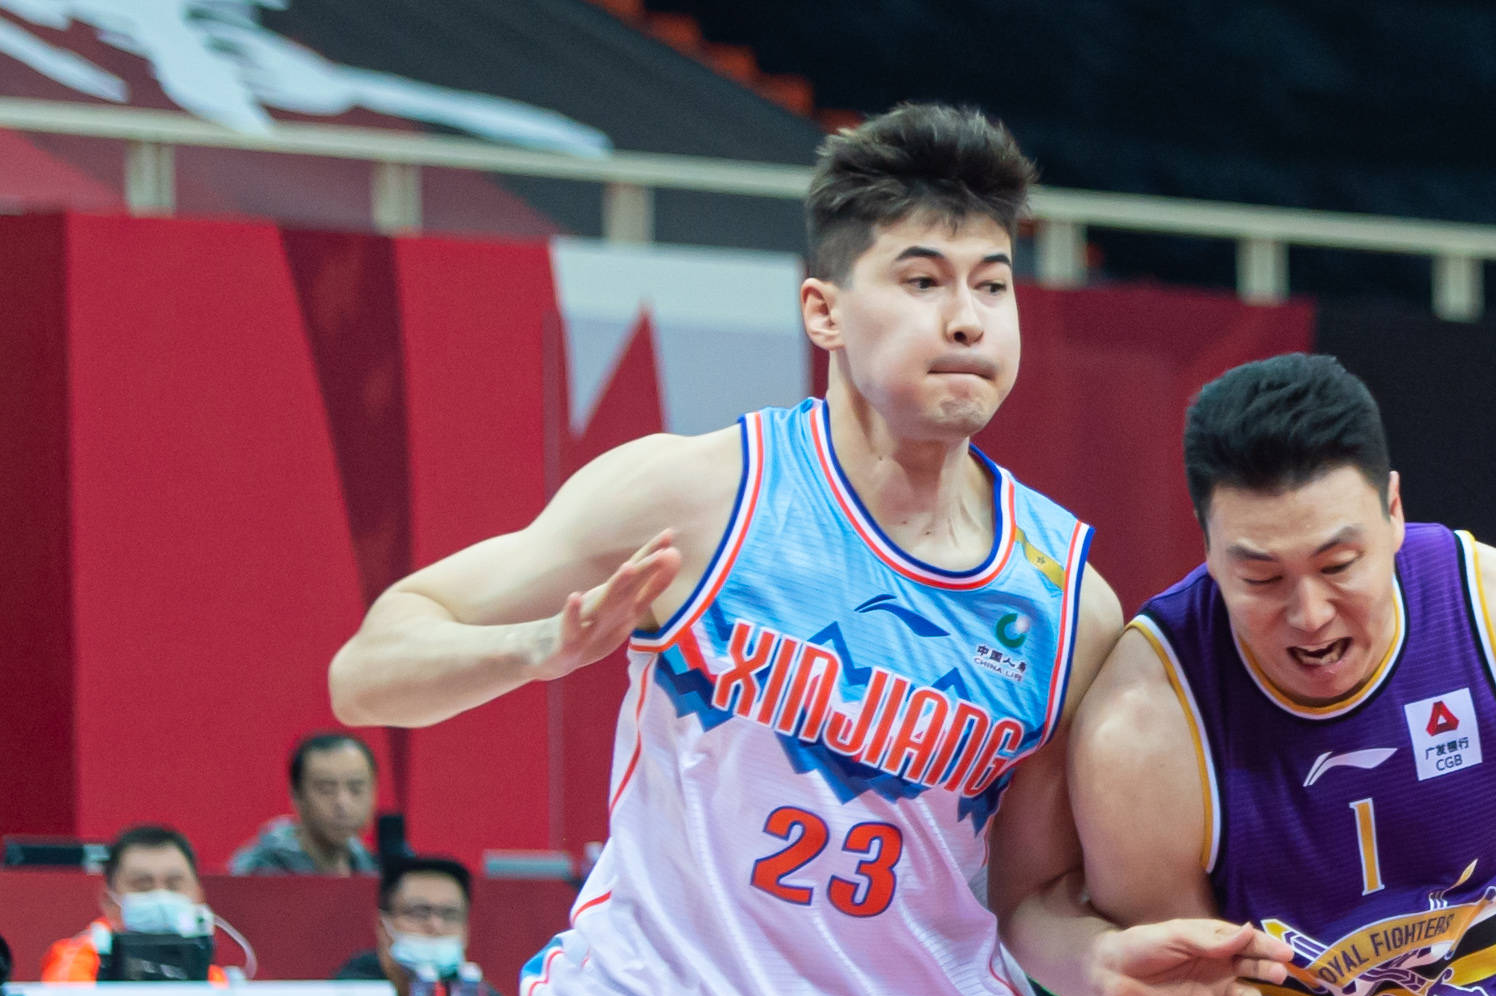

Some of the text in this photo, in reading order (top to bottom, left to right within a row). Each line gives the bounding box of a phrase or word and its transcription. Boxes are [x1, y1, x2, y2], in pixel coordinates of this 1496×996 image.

[973, 656, 1003, 674] CHINA
[711, 617, 1026, 798] XINJIANG
[1425, 736, 1470, 760] 广发银行
[1435, 753, 1463, 771] CGB
[750, 805, 904, 918] 23
[1349, 797, 1385, 896] 1
[1318, 912, 1456, 985] OYAL FIGHTERS
